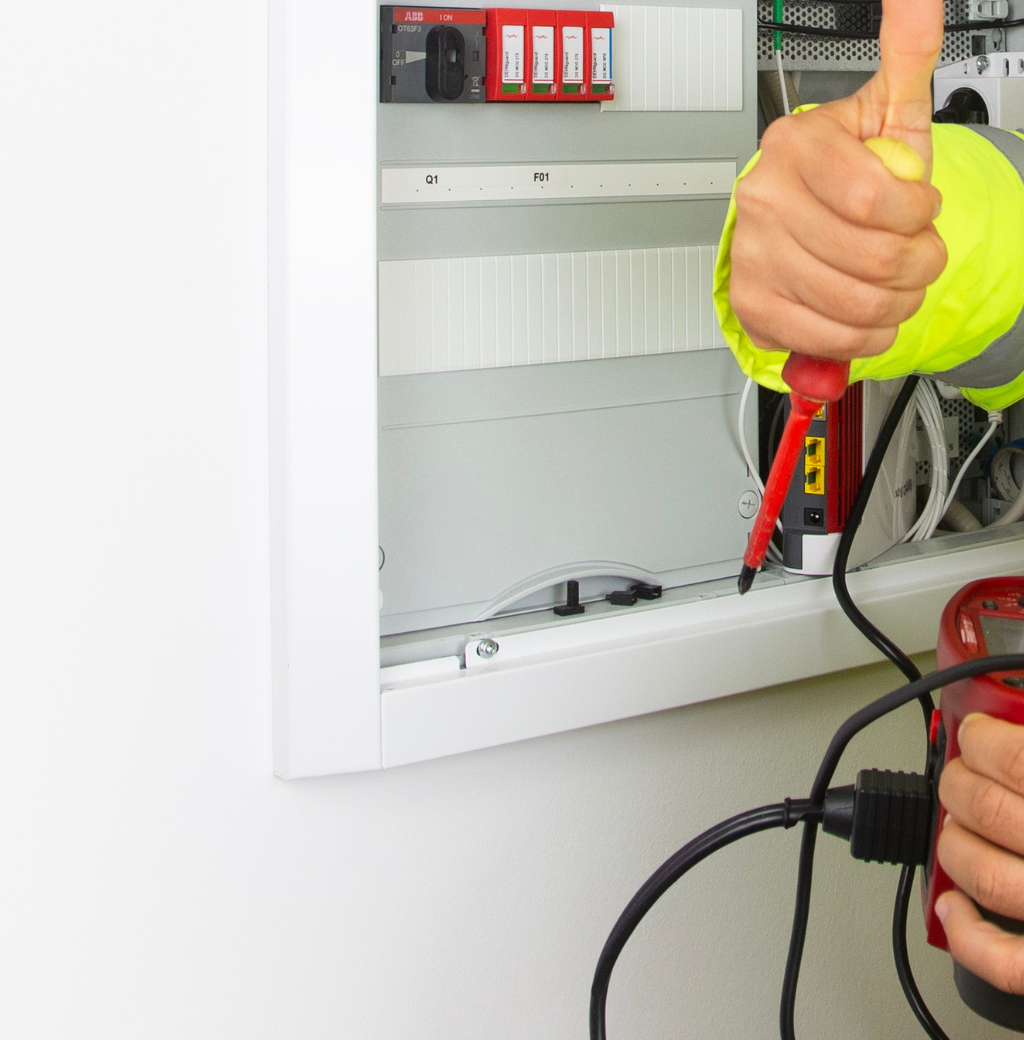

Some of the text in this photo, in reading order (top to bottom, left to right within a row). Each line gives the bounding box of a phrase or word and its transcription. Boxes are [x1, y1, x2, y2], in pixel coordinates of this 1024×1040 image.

[404, 11, 424, 22] ABB
[397, 25, 422, 33] OT63F3
[426, 173, 549, 185] Q1 F01
